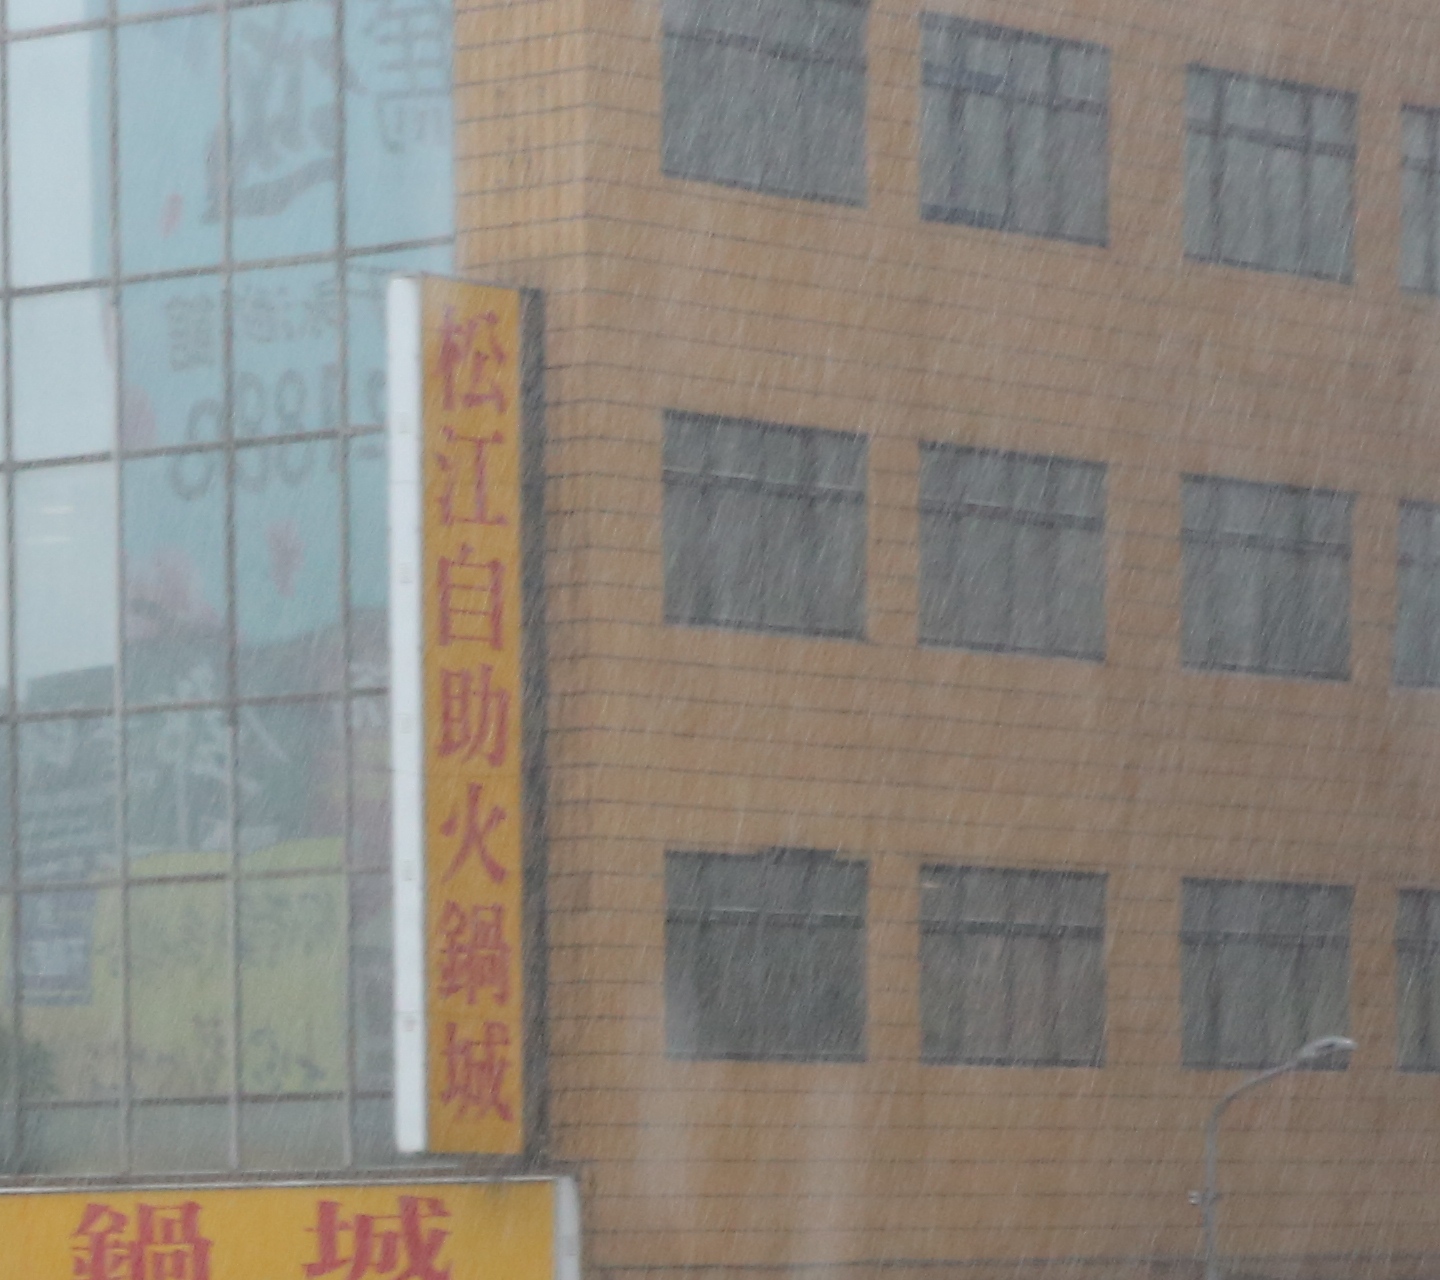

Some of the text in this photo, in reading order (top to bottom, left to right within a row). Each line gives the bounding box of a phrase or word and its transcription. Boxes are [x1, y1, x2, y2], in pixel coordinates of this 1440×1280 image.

[433, 304, 515, 1125] 松江自助火鍋城
